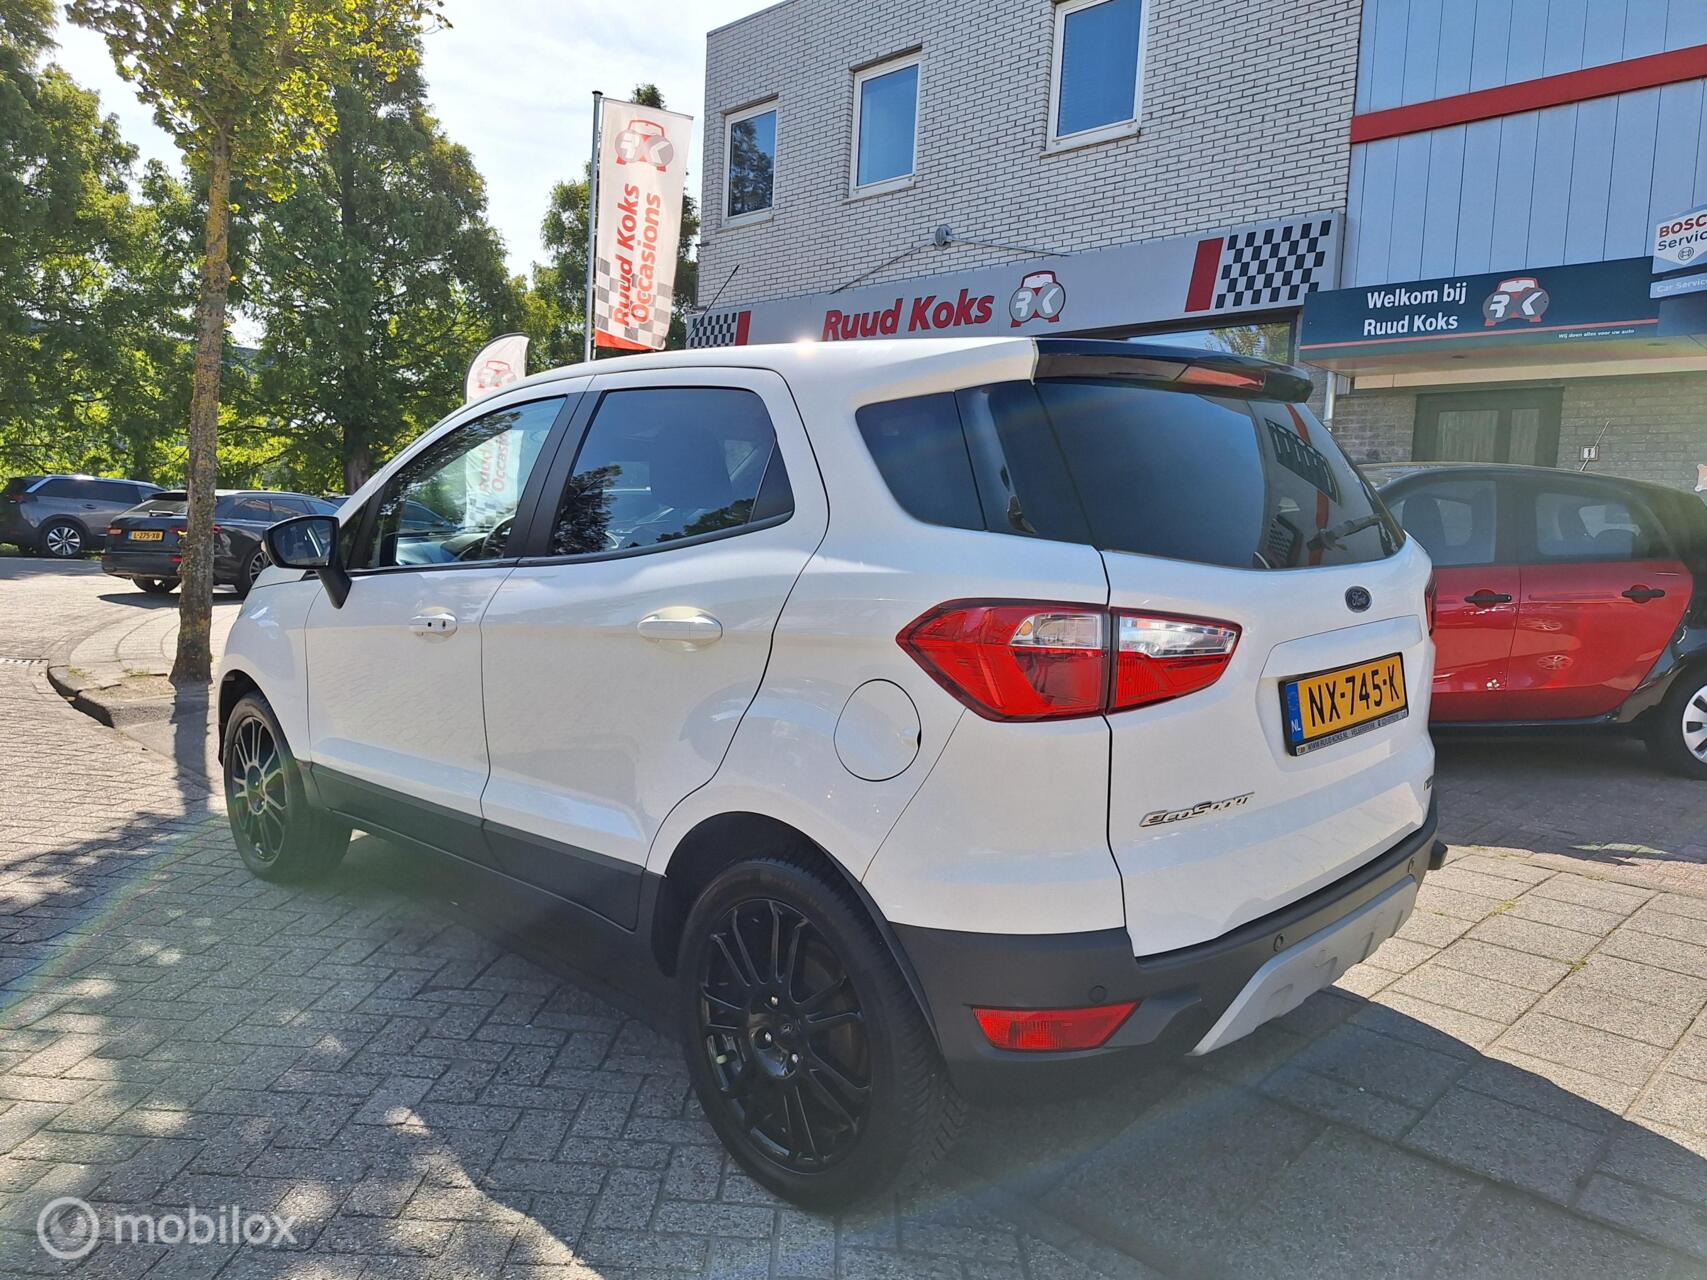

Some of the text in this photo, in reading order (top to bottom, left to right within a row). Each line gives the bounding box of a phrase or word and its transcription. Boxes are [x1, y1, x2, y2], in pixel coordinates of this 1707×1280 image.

[612, 183, 640, 328] Ruud Koks
[630, 193, 661, 324] Occasions
[822, 288, 995, 342] Ruud Koks
[1367, 282, 1467, 309] Welkom bij
[1363, 312, 1458, 336] Ruud Koks
[1307, 664, 1400, 727] NX-745-K
[1291, 718, 1301, 734] NL
